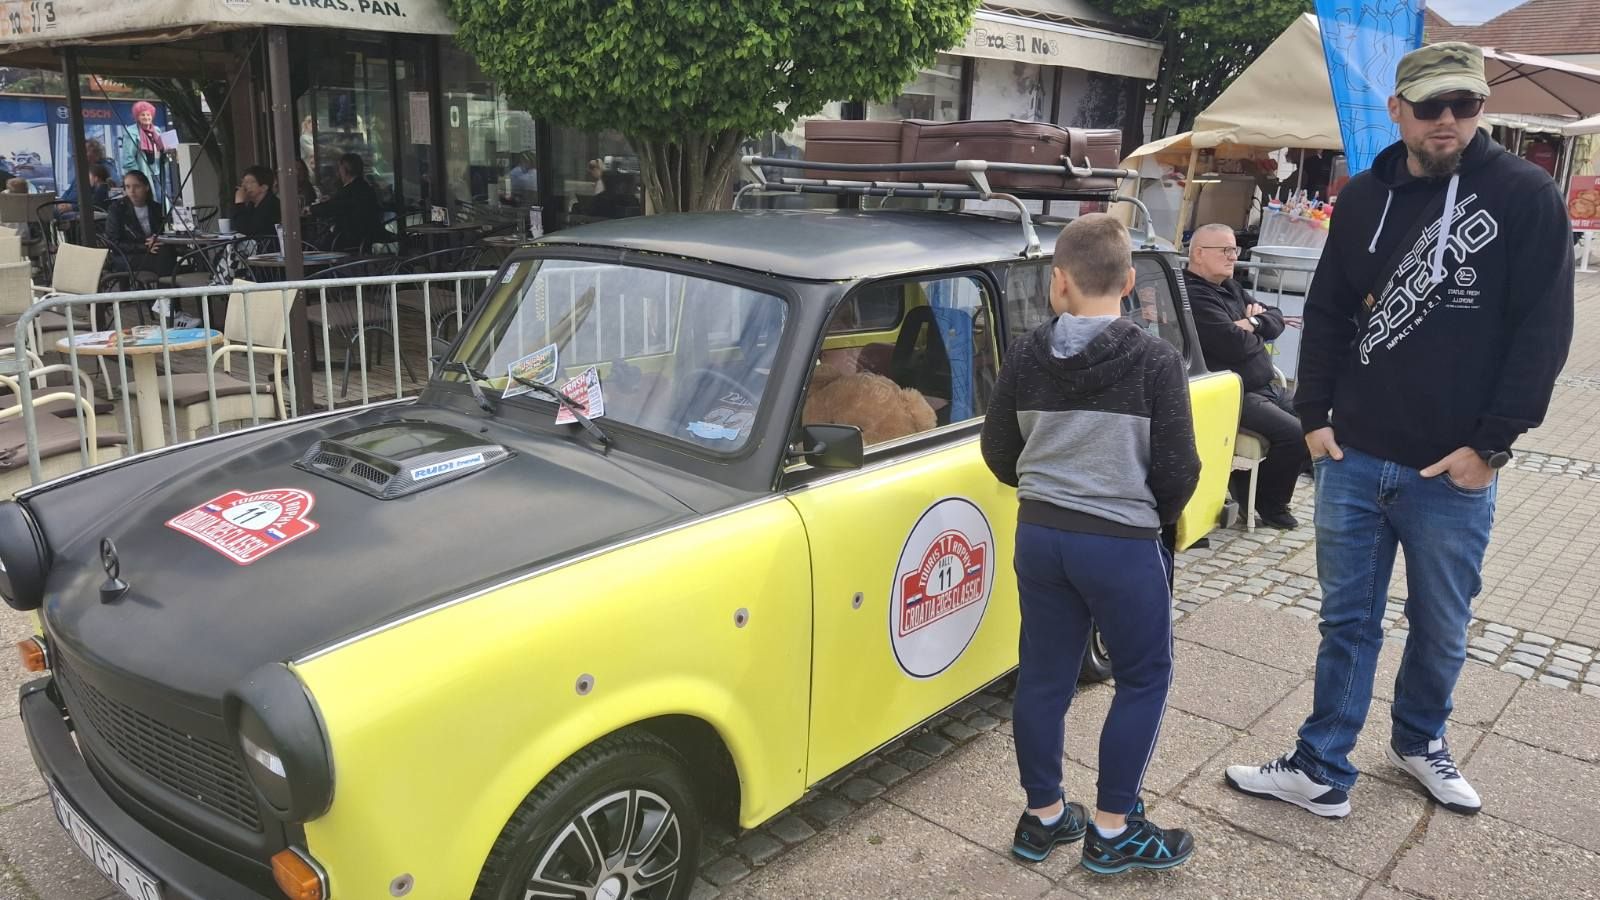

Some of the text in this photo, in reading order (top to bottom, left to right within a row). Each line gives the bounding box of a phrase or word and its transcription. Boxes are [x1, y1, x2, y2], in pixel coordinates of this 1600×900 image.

[360, 0, 407, 17] PAN.
[81, 109, 112, 118] OSCH
[1386, 324, 1413, 350] IMPACT
[414, 462, 454, 478] RUDI
[232, 505, 266, 524] 11
[939, 567, 952, 591] 11
[905, 598, 936, 630] CROATIA
[952, 578, 981, 609] CLASSIC
